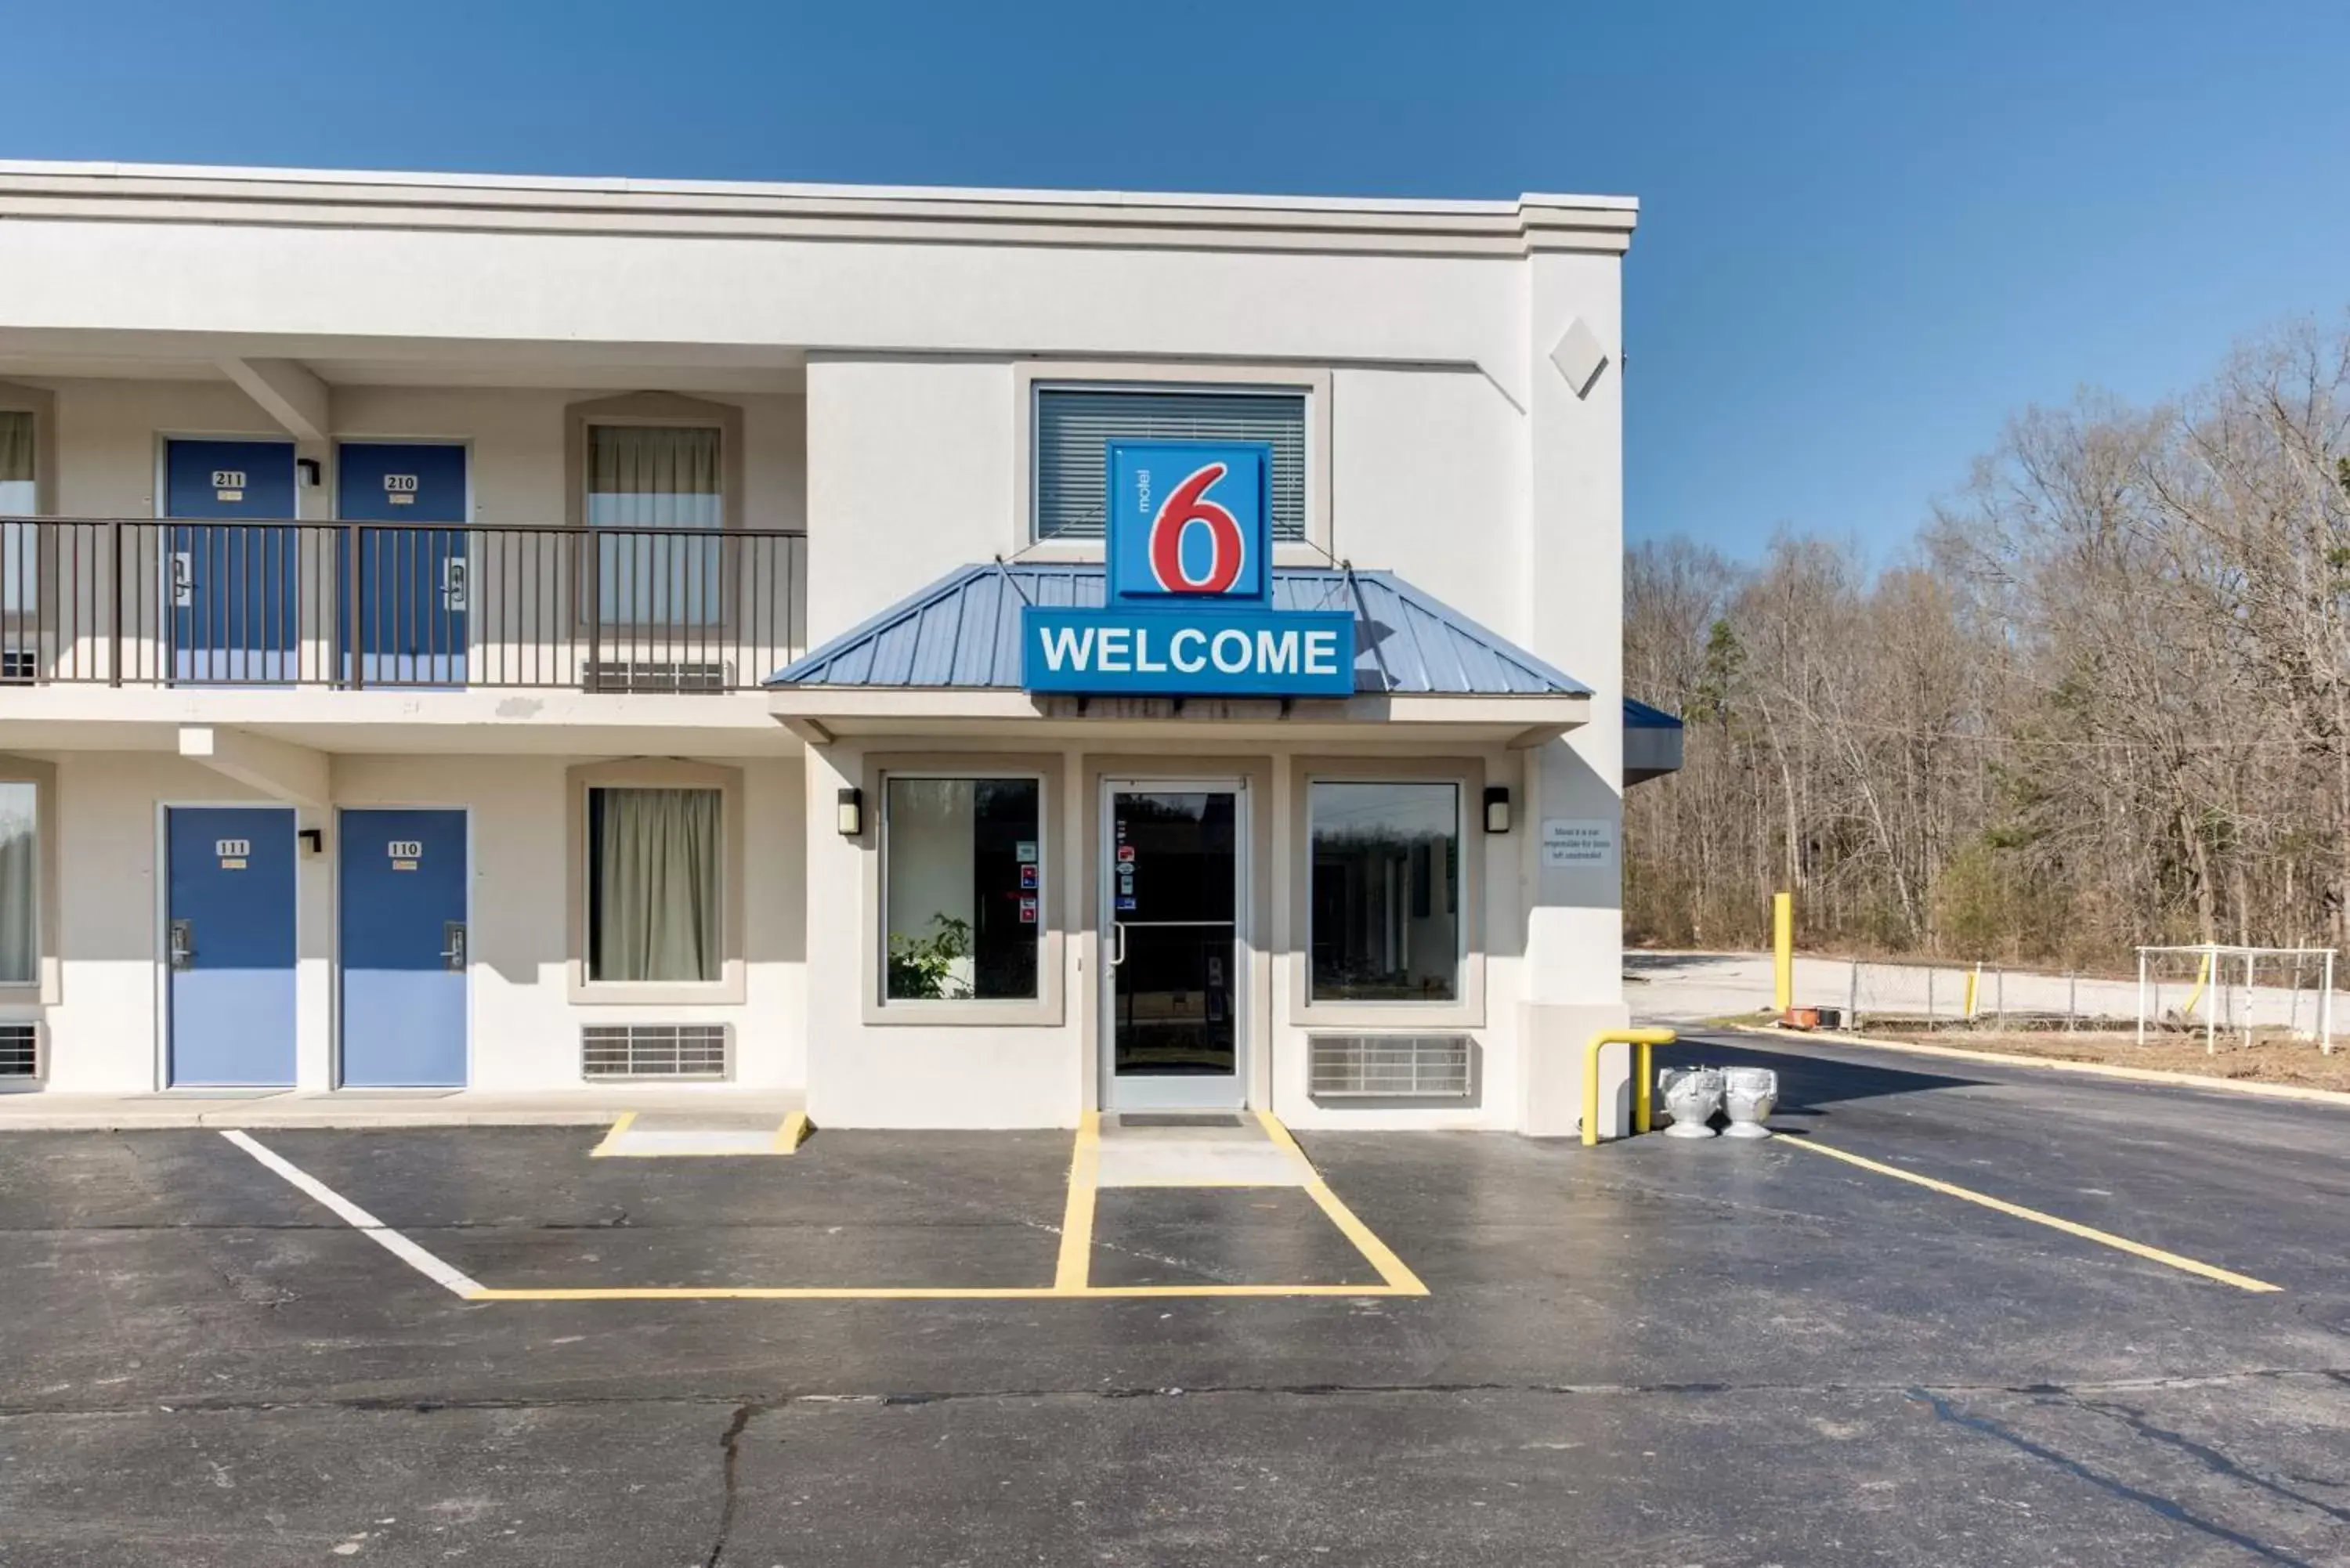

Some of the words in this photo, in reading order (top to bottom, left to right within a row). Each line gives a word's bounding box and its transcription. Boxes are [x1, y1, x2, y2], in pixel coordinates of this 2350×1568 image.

[215, 472, 241, 486] 211
[388, 476, 414, 490] 210
[1135, 469, 1150, 513] motel
[1148, 461, 1245, 593] 6
[1039, 627, 1338, 675] WELCOME
[220, 842, 245, 854] 111
[392, 843, 418, 855] 110
